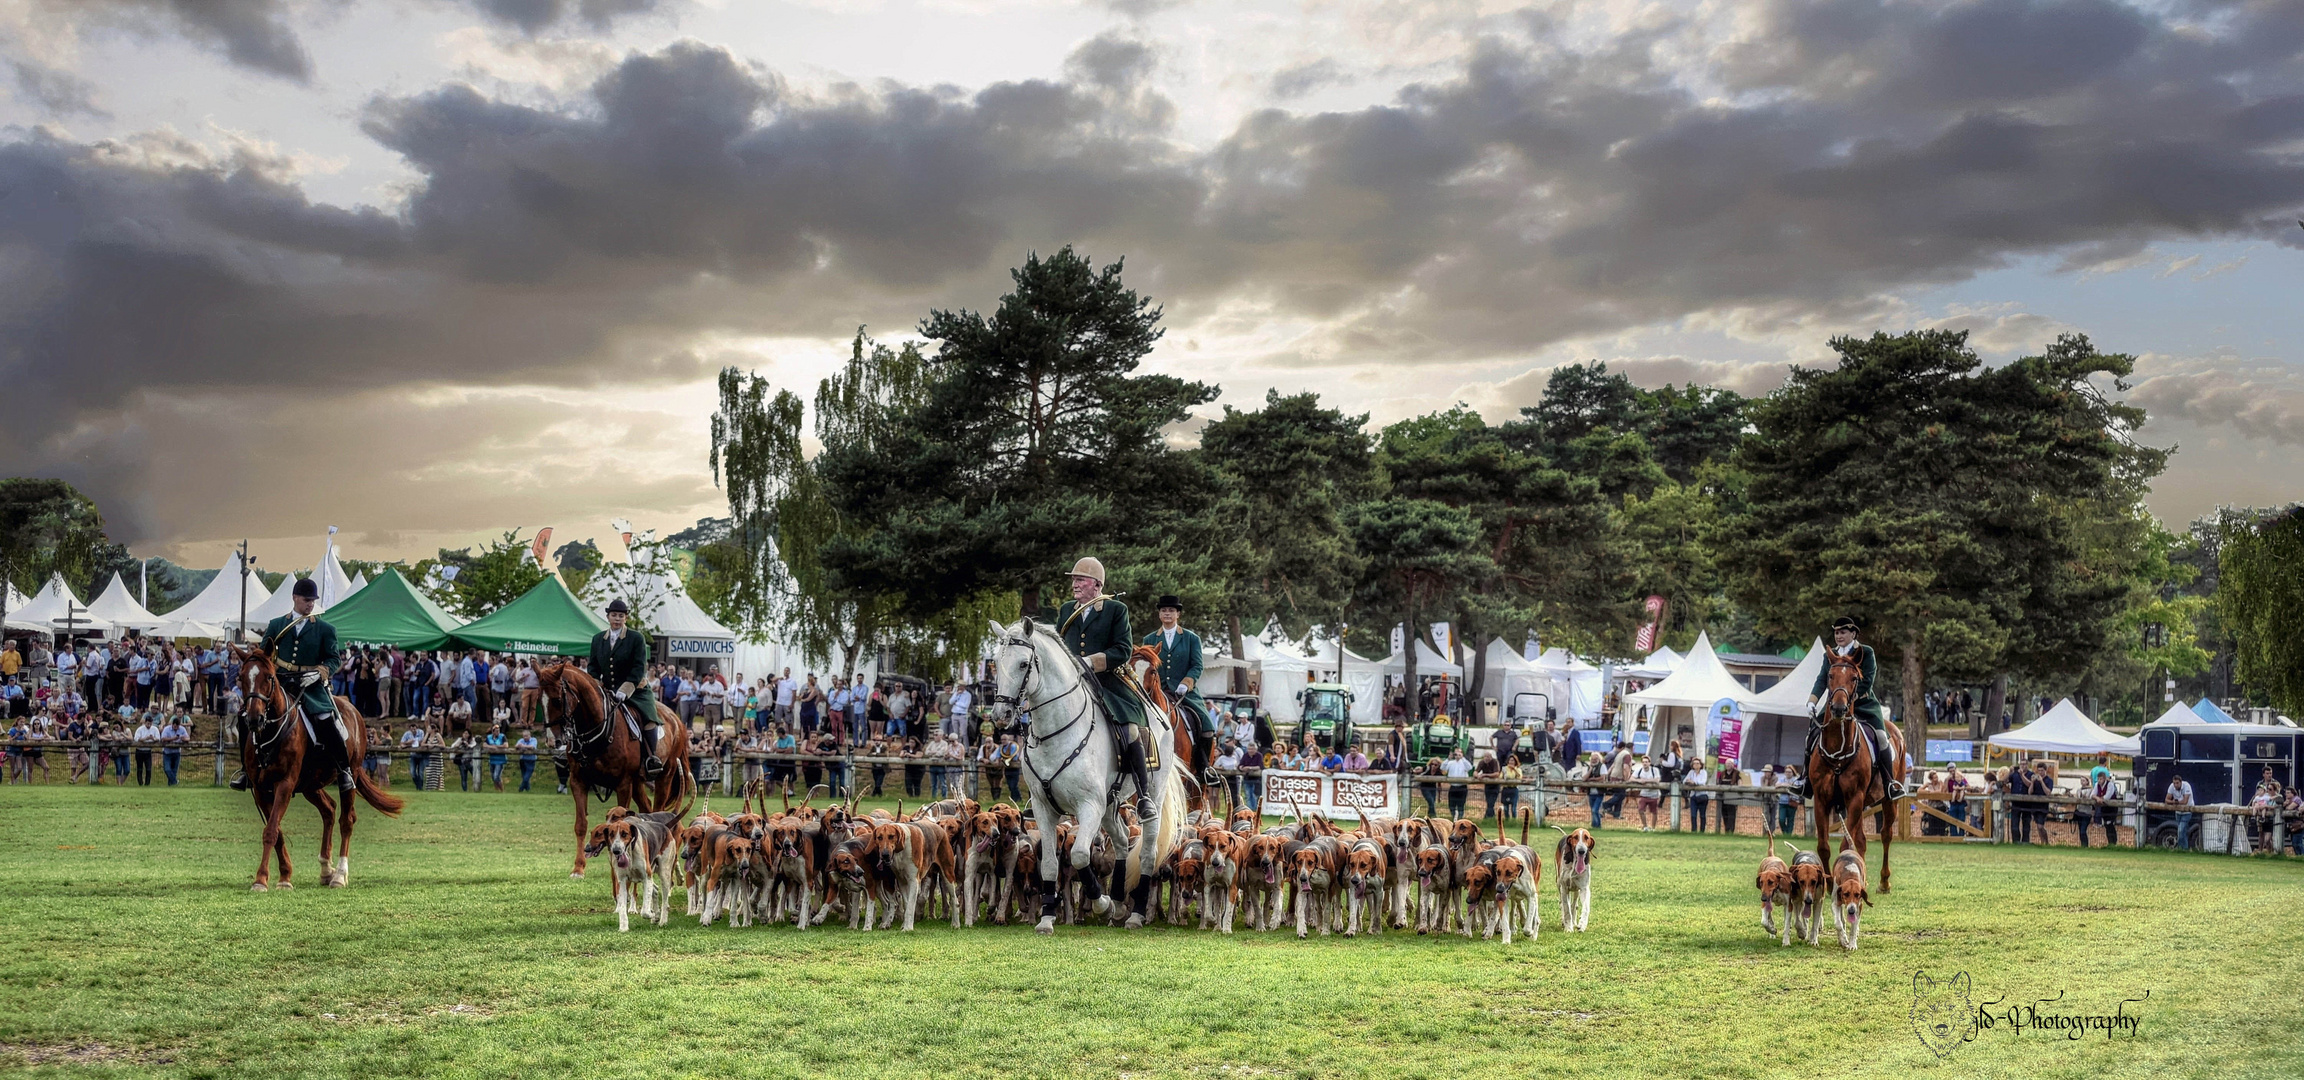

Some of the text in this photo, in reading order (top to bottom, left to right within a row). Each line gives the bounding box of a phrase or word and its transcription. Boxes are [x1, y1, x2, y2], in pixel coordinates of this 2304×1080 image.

[514, 641, 559, 652] Heineken
[671, 640, 734, 653] SANDWICHS
[1269, 776, 1317, 790] Chasse
[1337, 780, 1383, 794] Chasse
